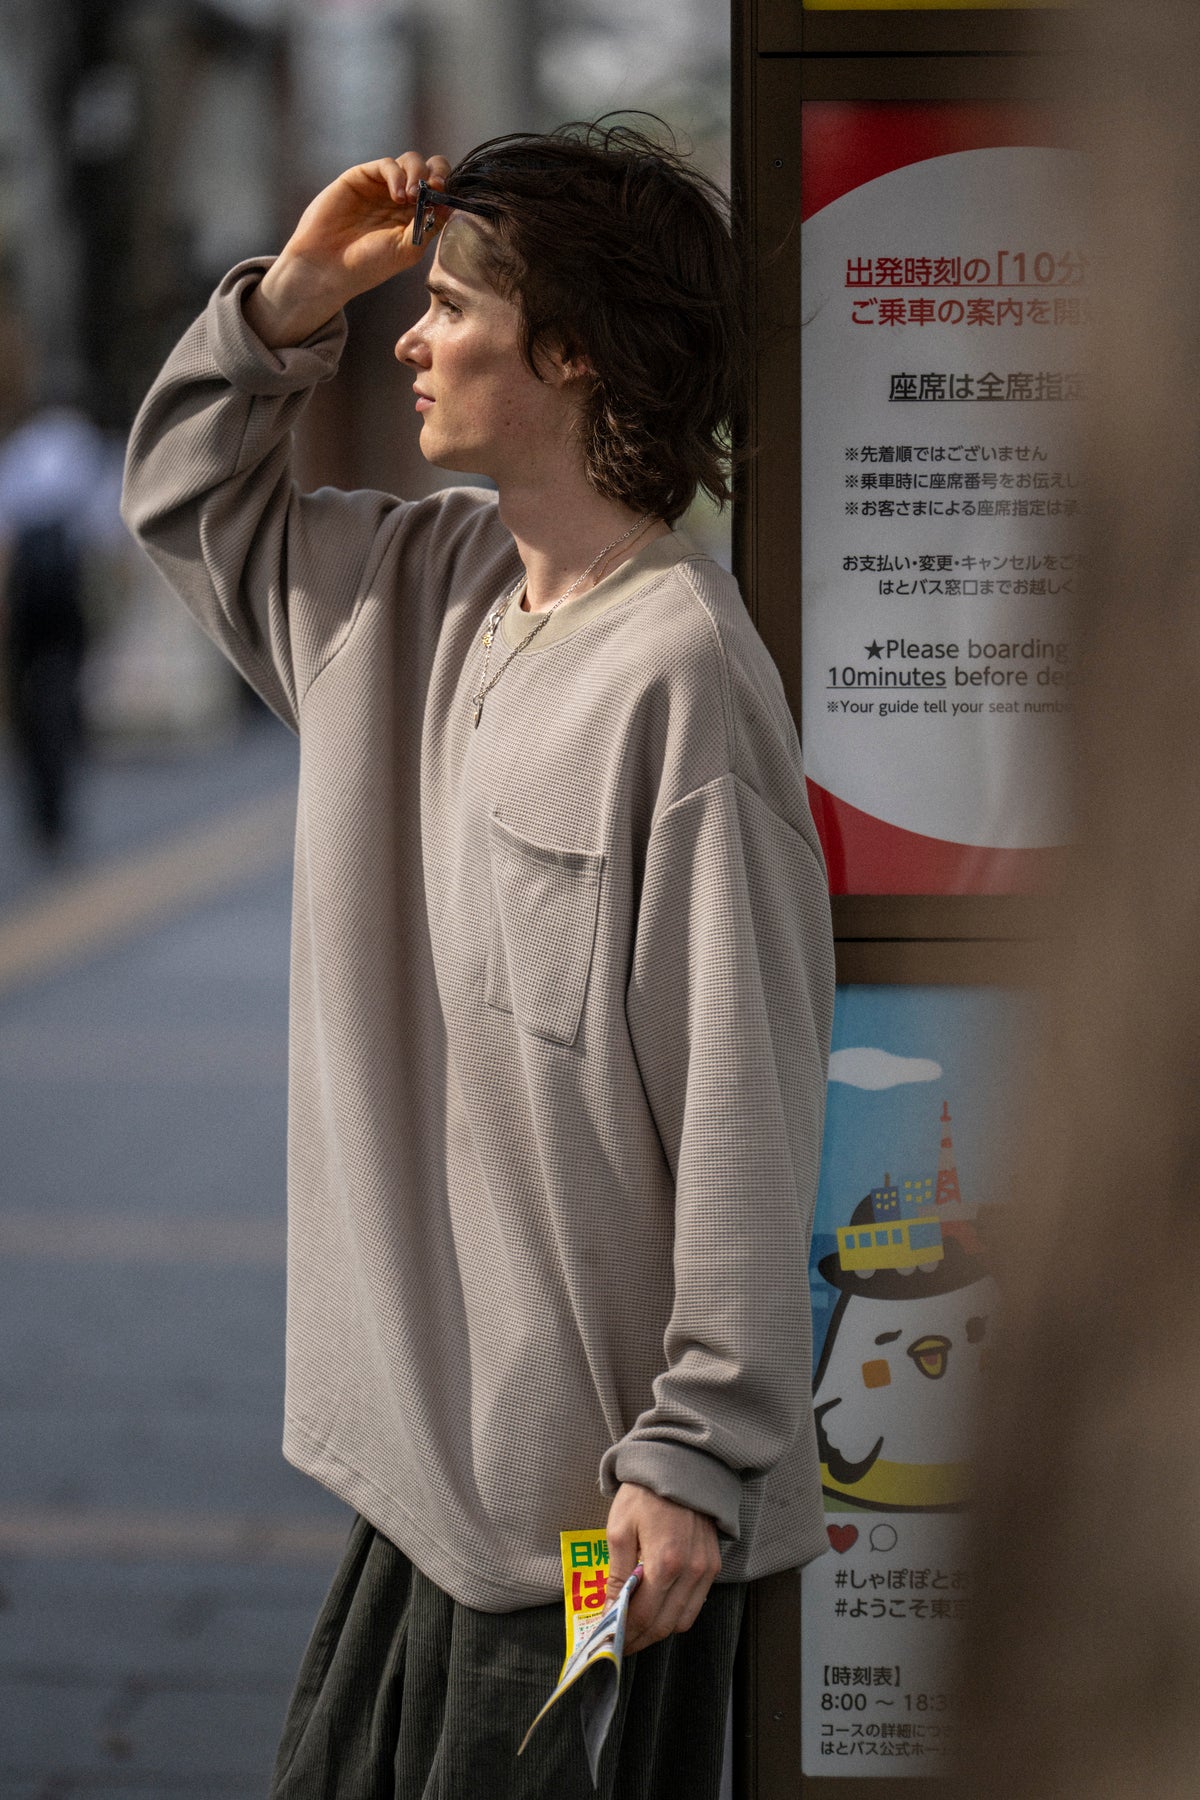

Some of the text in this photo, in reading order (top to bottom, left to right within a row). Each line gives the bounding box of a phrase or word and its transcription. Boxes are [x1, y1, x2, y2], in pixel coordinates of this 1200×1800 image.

[845, 445, 1048, 463] ※先着順ではございません
[842, 555, 1081, 572] お支払い・変更・キャンセルをご
[968, 639, 1069, 664] boarding
[827, 666, 946, 689] 10minutes
[955, 666, 1028, 686] before
[879, 699, 919, 717] guide
[924, 699, 948, 713] tell
[952, 702, 983, 716] your
[988, 702, 1021, 713] seat
[823, 1666, 900, 1687] 【時刻表】
[821, 1693, 867, 1711] 8:00
[904, 1693, 949, 1711] 18:3
